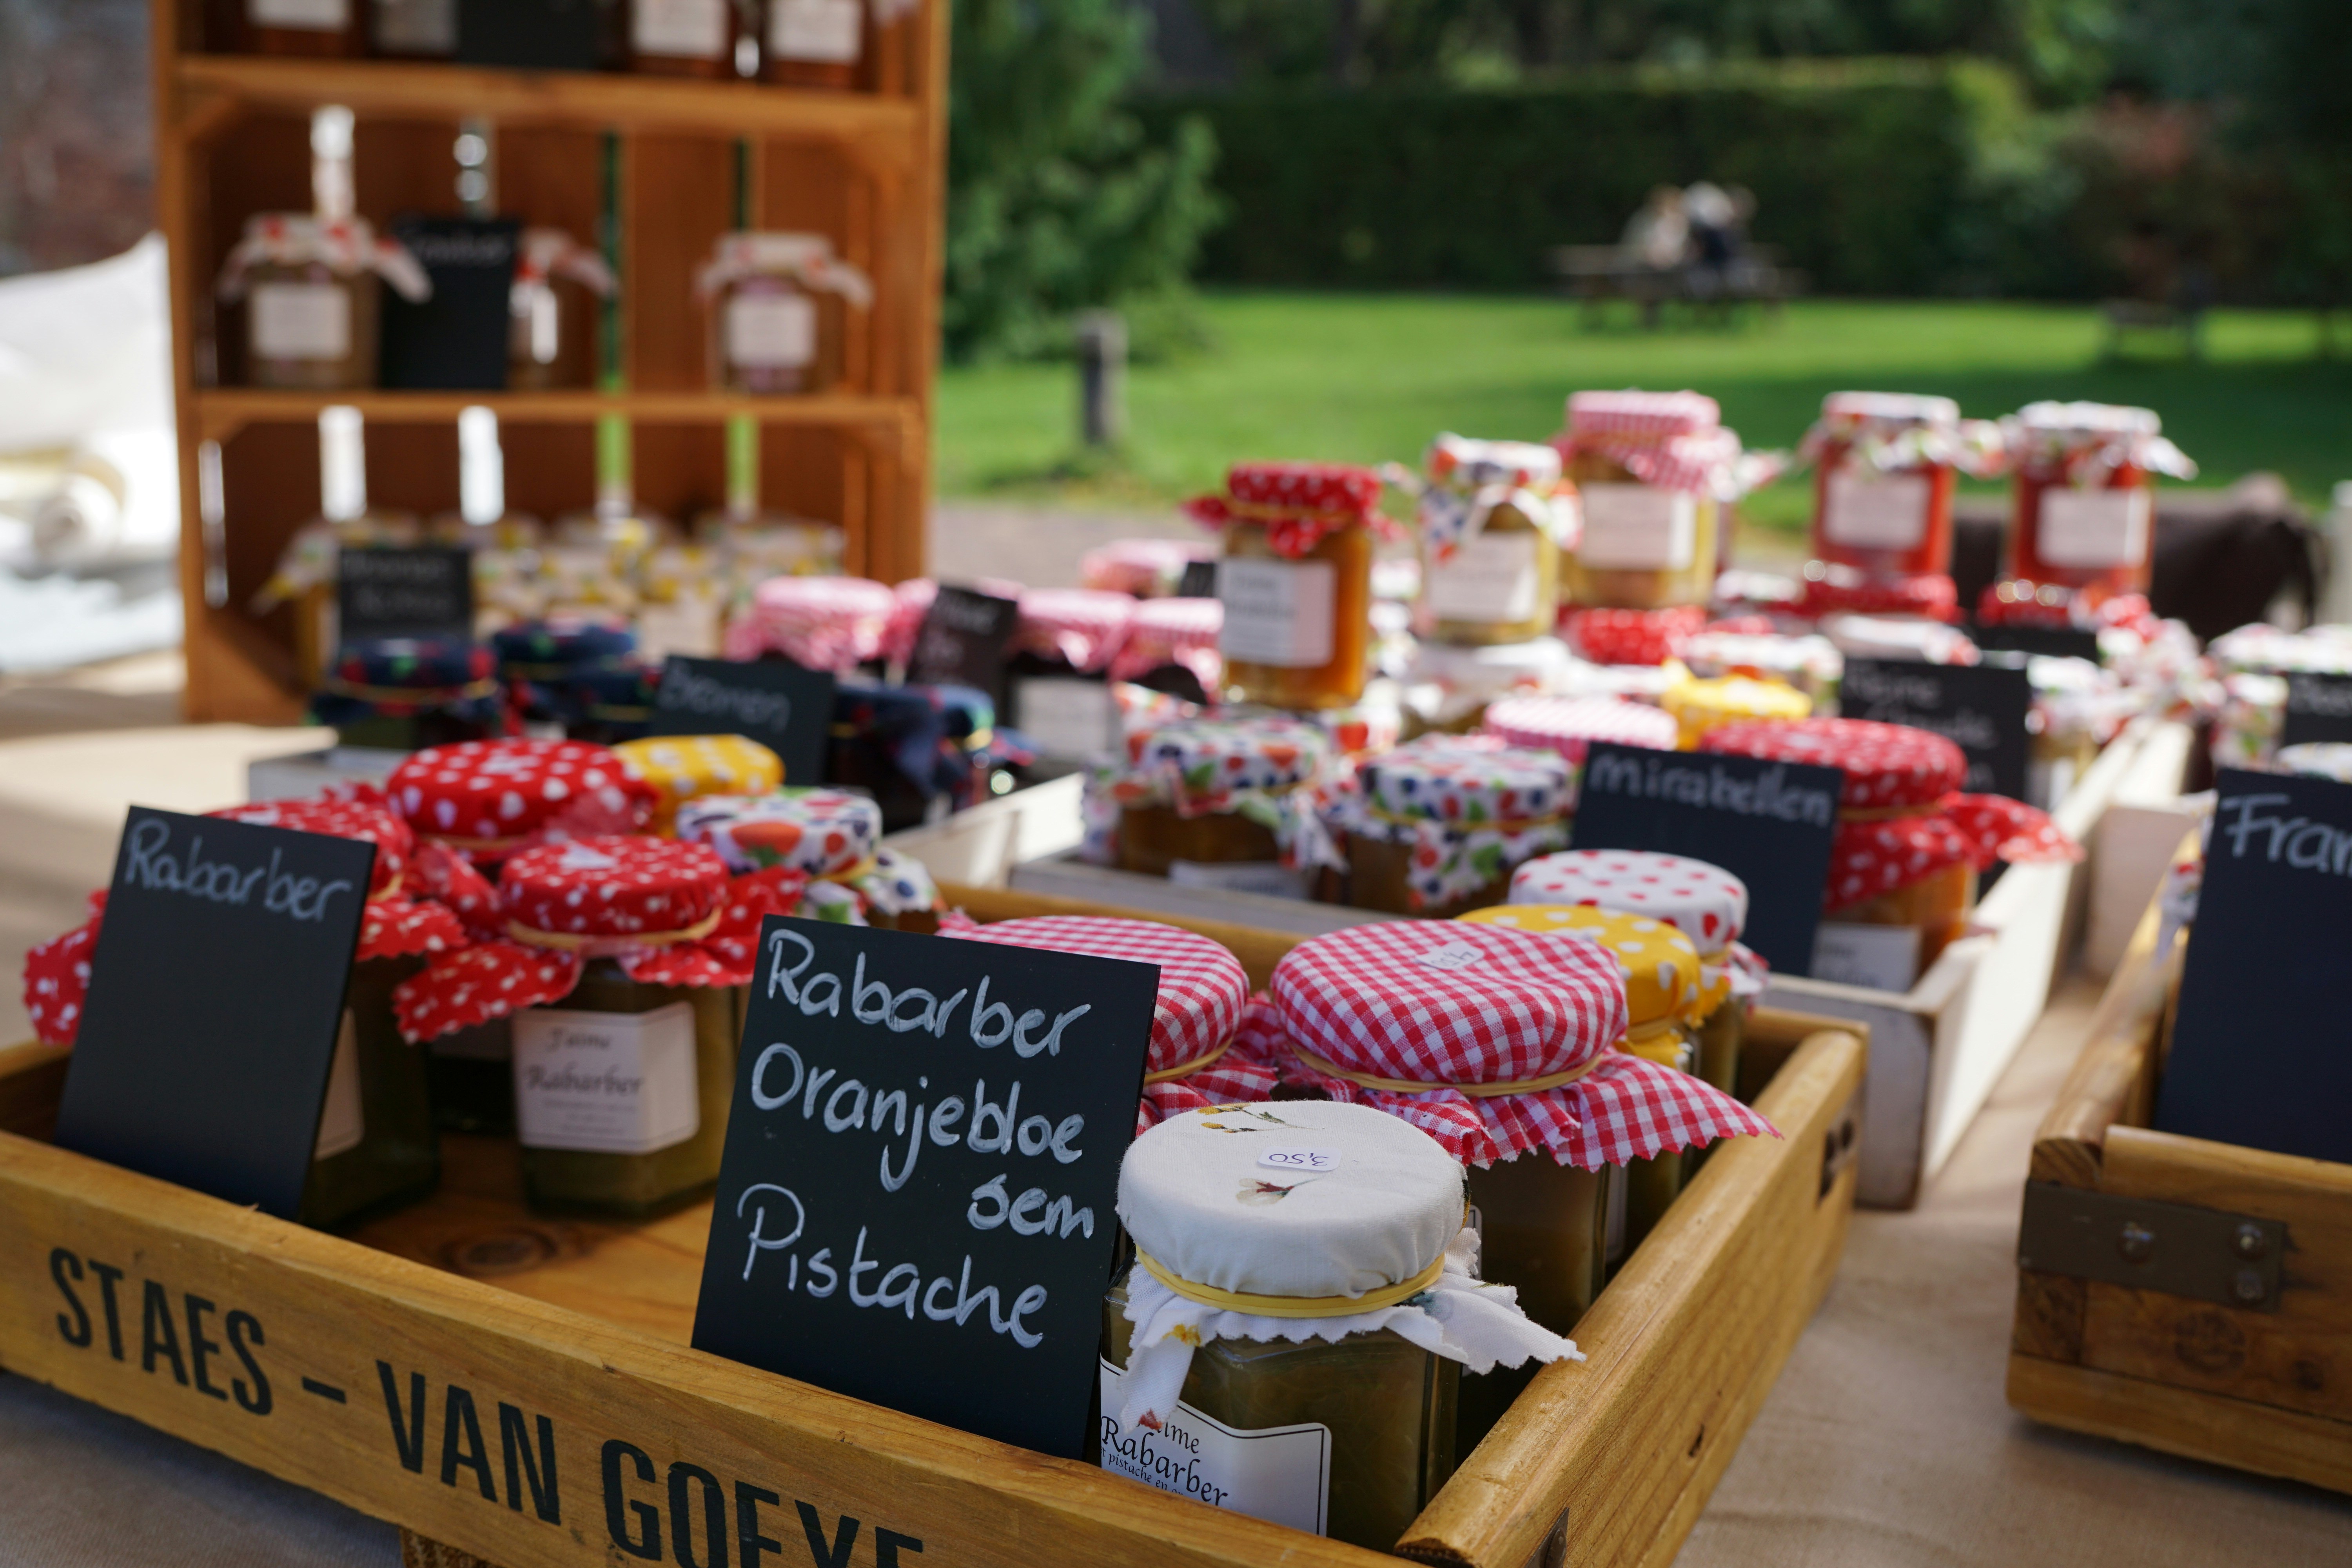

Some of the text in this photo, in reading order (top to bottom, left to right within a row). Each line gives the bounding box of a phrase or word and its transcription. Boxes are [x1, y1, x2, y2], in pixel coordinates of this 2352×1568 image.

[123, 817, 352, 924] Rabarber
[767, 928, 1091, 1058] Rabarber
[751, 1042, 1085, 1192] Oranjebloe
[1268, 1152, 1330, 1167] 3,50
[737, 1183, 1048, 1348] Pistache
[49, 1247, 272, 1416] STAES
[375, 1359, 562, 1526] VAN
[1101, 1416, 1229, 1506] Rabarber
[1109, 1453, 1152, 1483] pistache
